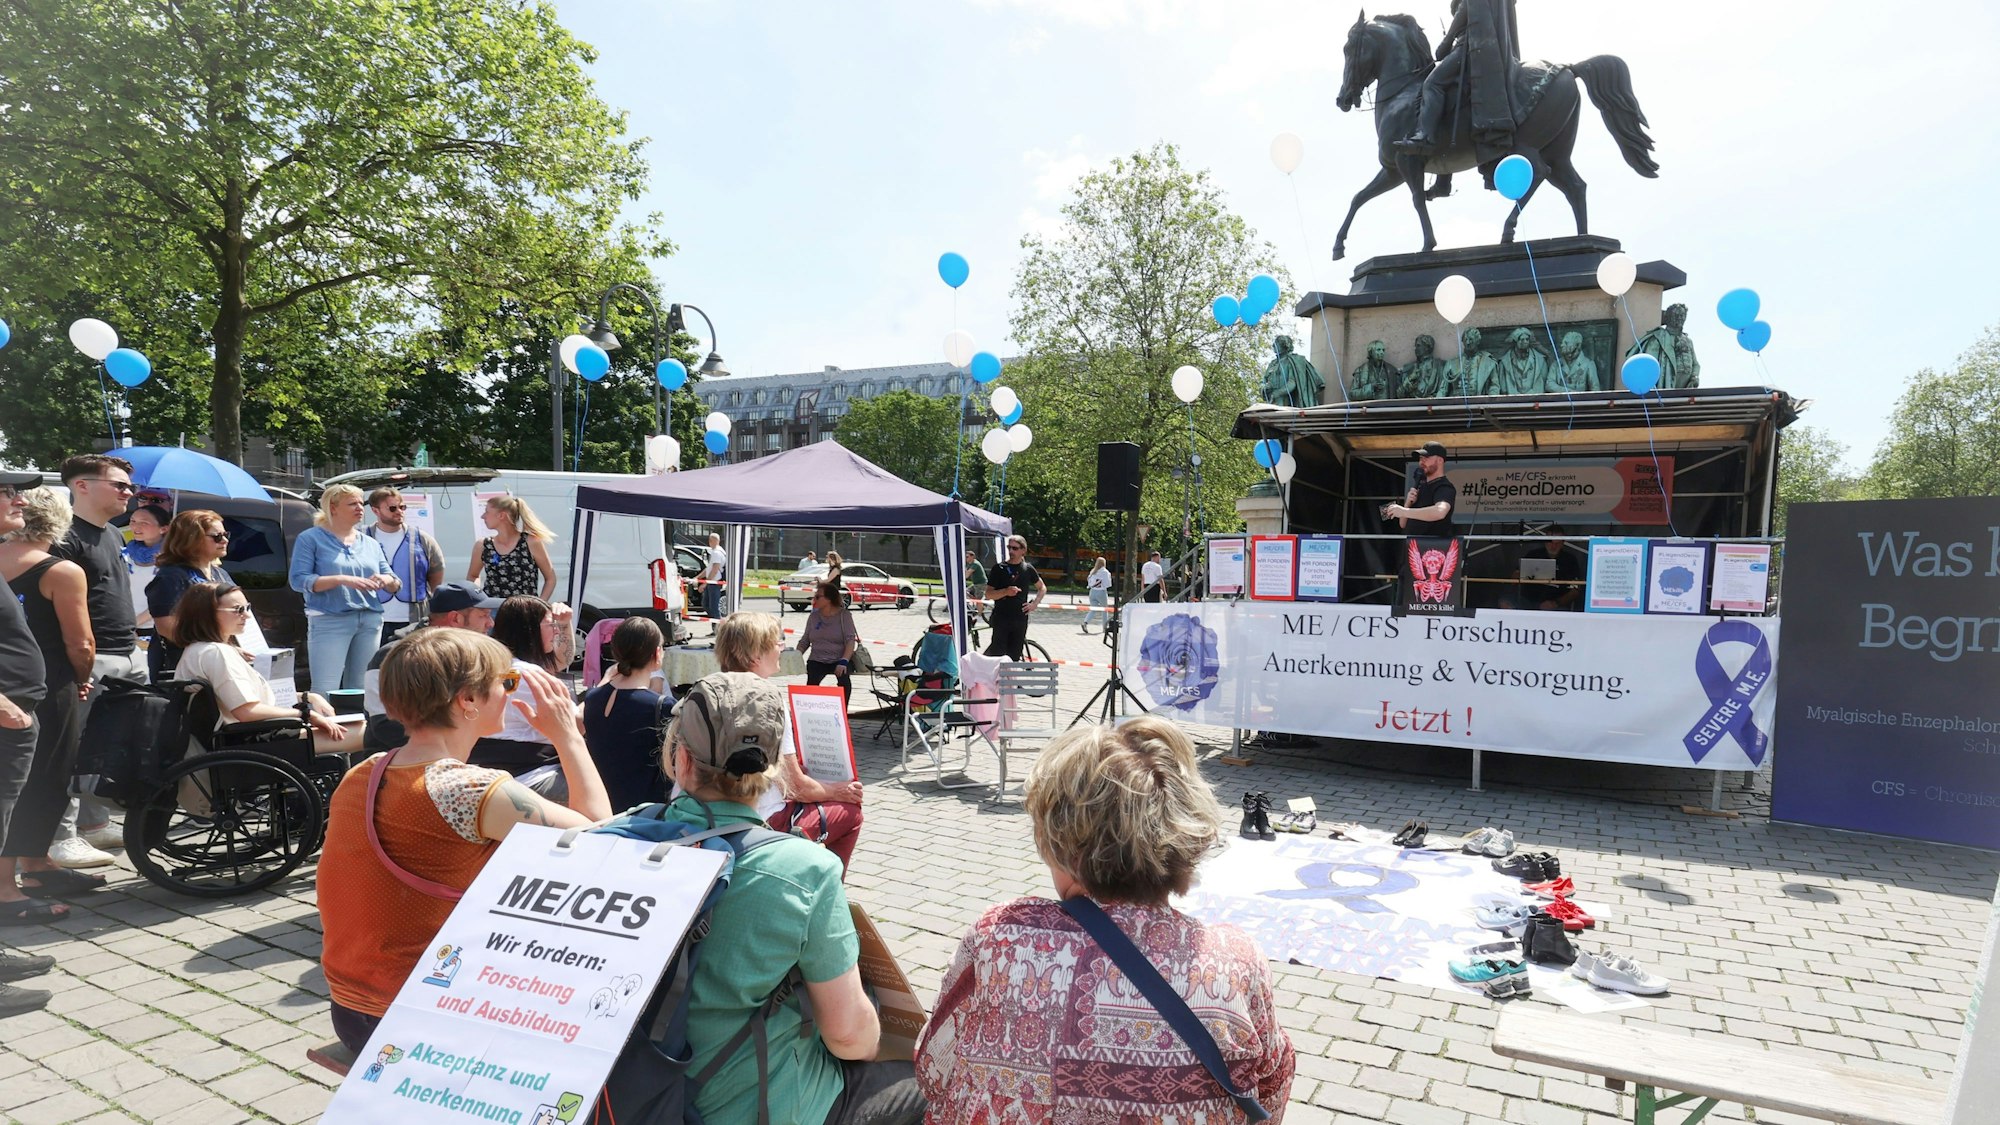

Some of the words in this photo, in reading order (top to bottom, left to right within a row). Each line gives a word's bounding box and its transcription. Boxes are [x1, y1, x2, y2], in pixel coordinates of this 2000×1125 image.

[1462, 481, 1595, 499] #LiegendDemo
[1505, 471, 1547, 482] ME/CFS
[1858, 531, 1973, 577] Was
[1282, 614, 1324, 636] ME
[1348, 615, 1399, 639] CFS
[1424, 618, 1573, 652] Forschung,
[1160, 686, 1200, 697] ME/CFS
[1263, 651, 1424, 686] Anerkennung
[1432, 659, 1455, 682] &
[1464, 660, 1631, 699] Versorgung.
[1736, 671, 1766, 696] M.E.
[796, 700, 839, 709] #LiegendDemo
[1375, 700, 1452, 734] Jetzt
[1693, 698, 1742, 746] SEVERE
[1806, 705, 1897, 725] Myalgische
[1963, 737, 2000, 755] Sch
[1872, 780, 1905, 796] CFS
[496, 874, 657, 930] ME/CFS
[485, 931, 521, 953] Wir
[525, 938, 607, 972] fordern:
[476, 964, 577, 1004] Forschung
[436, 992, 474, 1019] und
[474, 998, 581, 1043] Ausbildung
[407, 1042, 507, 1081] Akzeptanz
[509, 1070, 551, 1092] und
[393, 1077, 523, 1125] Anerkennung
